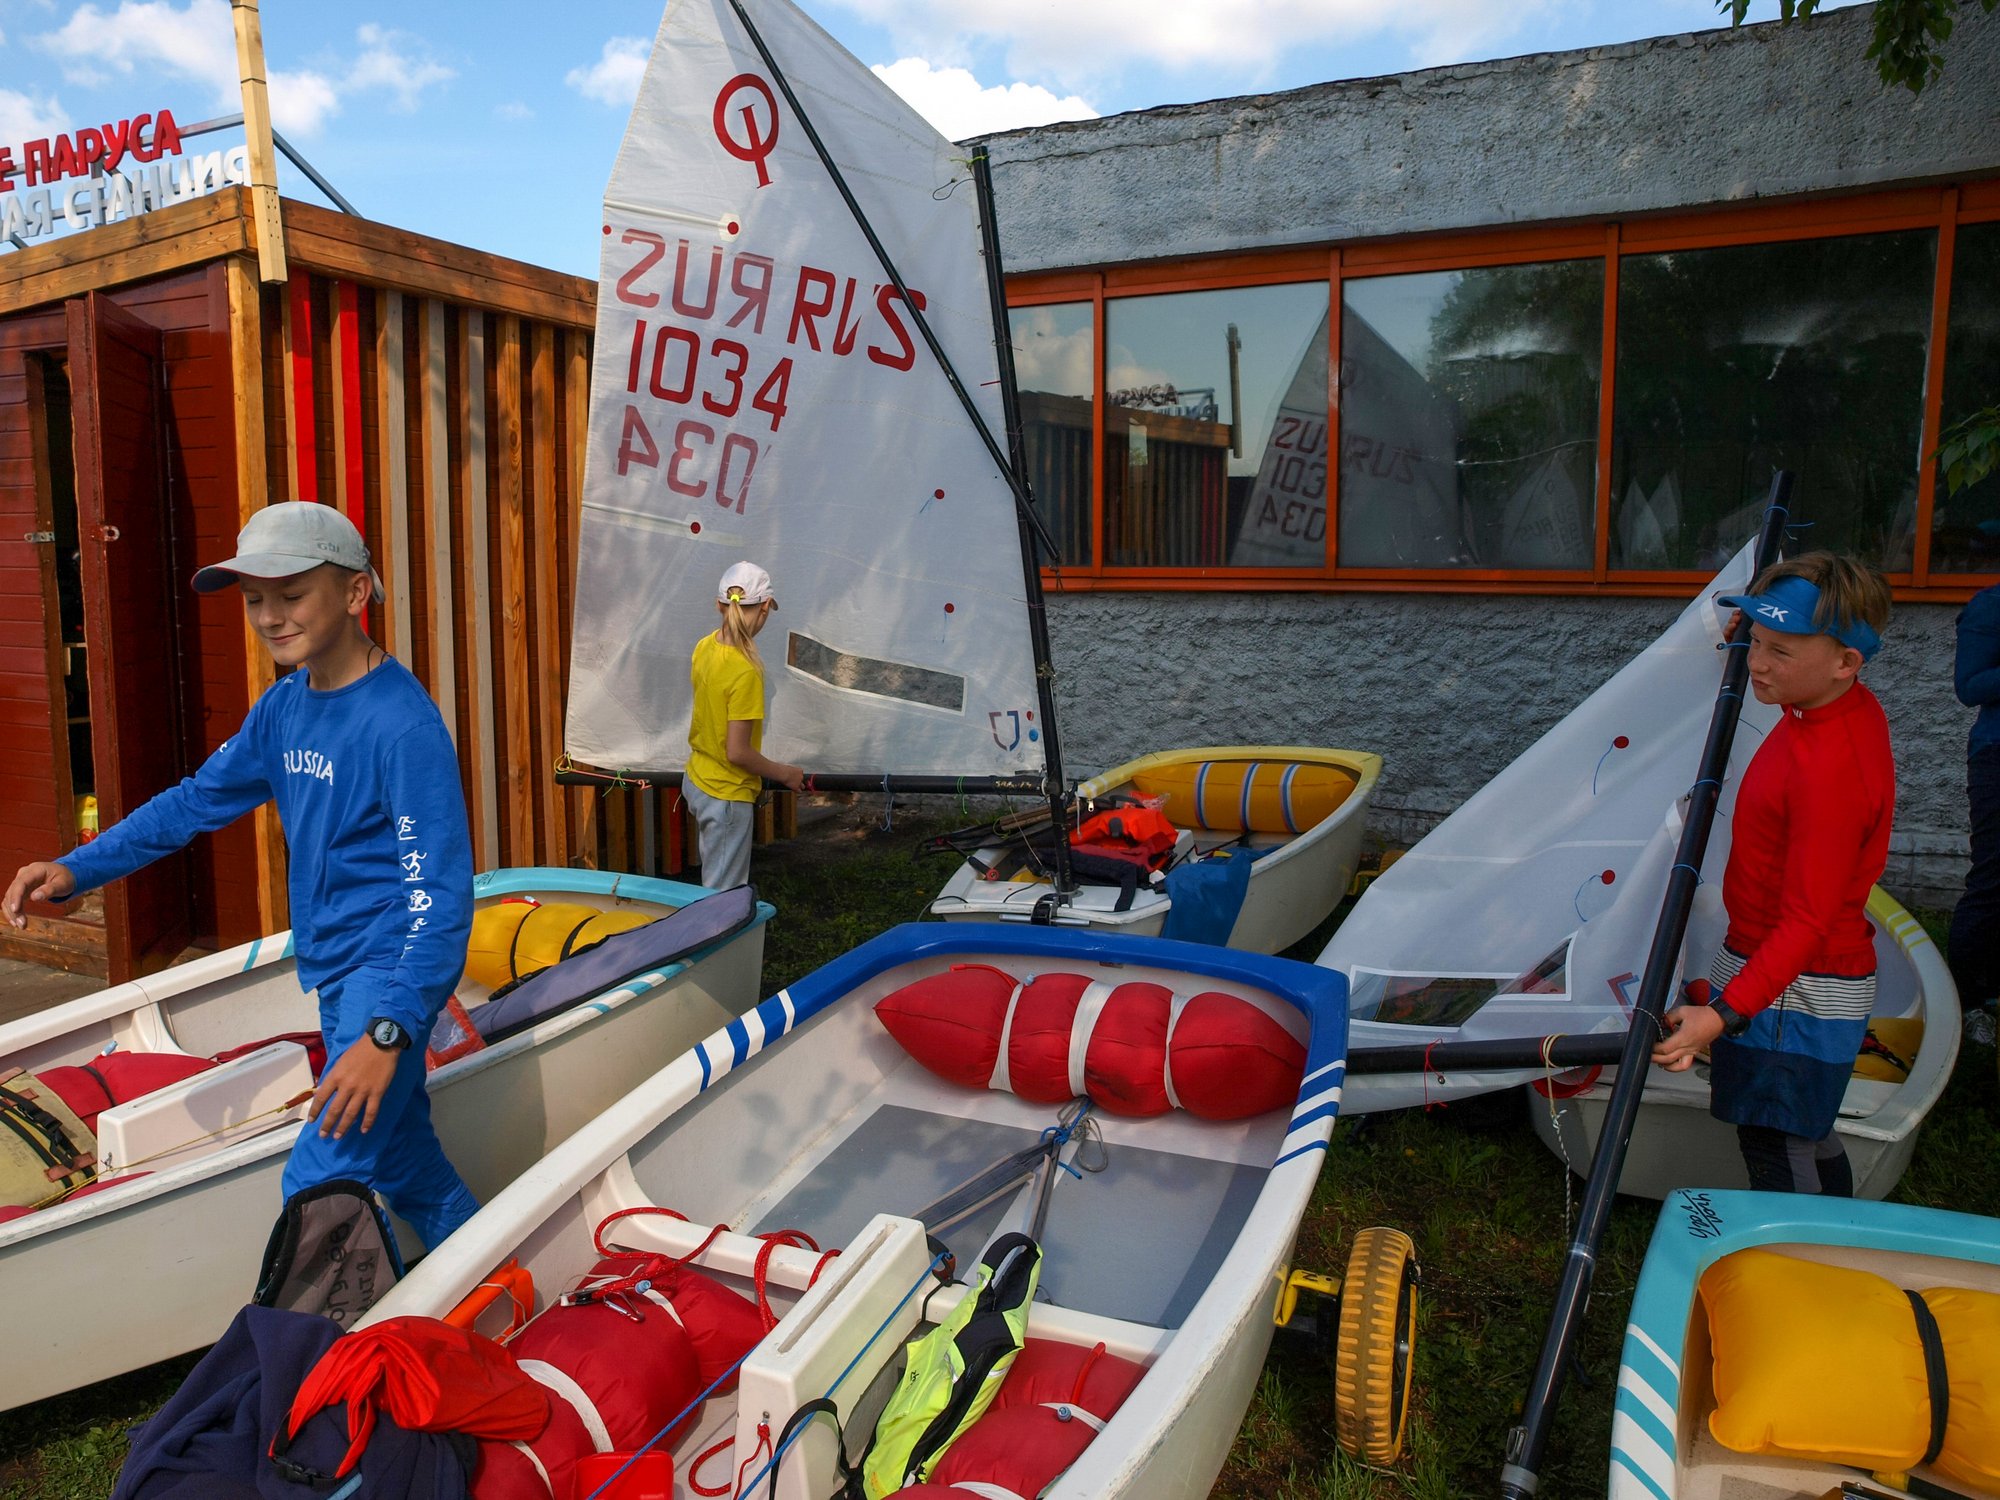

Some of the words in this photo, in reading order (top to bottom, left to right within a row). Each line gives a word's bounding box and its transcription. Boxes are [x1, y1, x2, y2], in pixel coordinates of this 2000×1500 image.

[0, 189, 52, 243] АЯ
[64, 145, 253, 229] СТАНЦИЯ
[24, 109, 182, 187] ПАРУСА
[787, 265, 927, 372] RUS
[627, 319, 793, 432] 1034
[283, 749, 334, 786] RUSSIA
